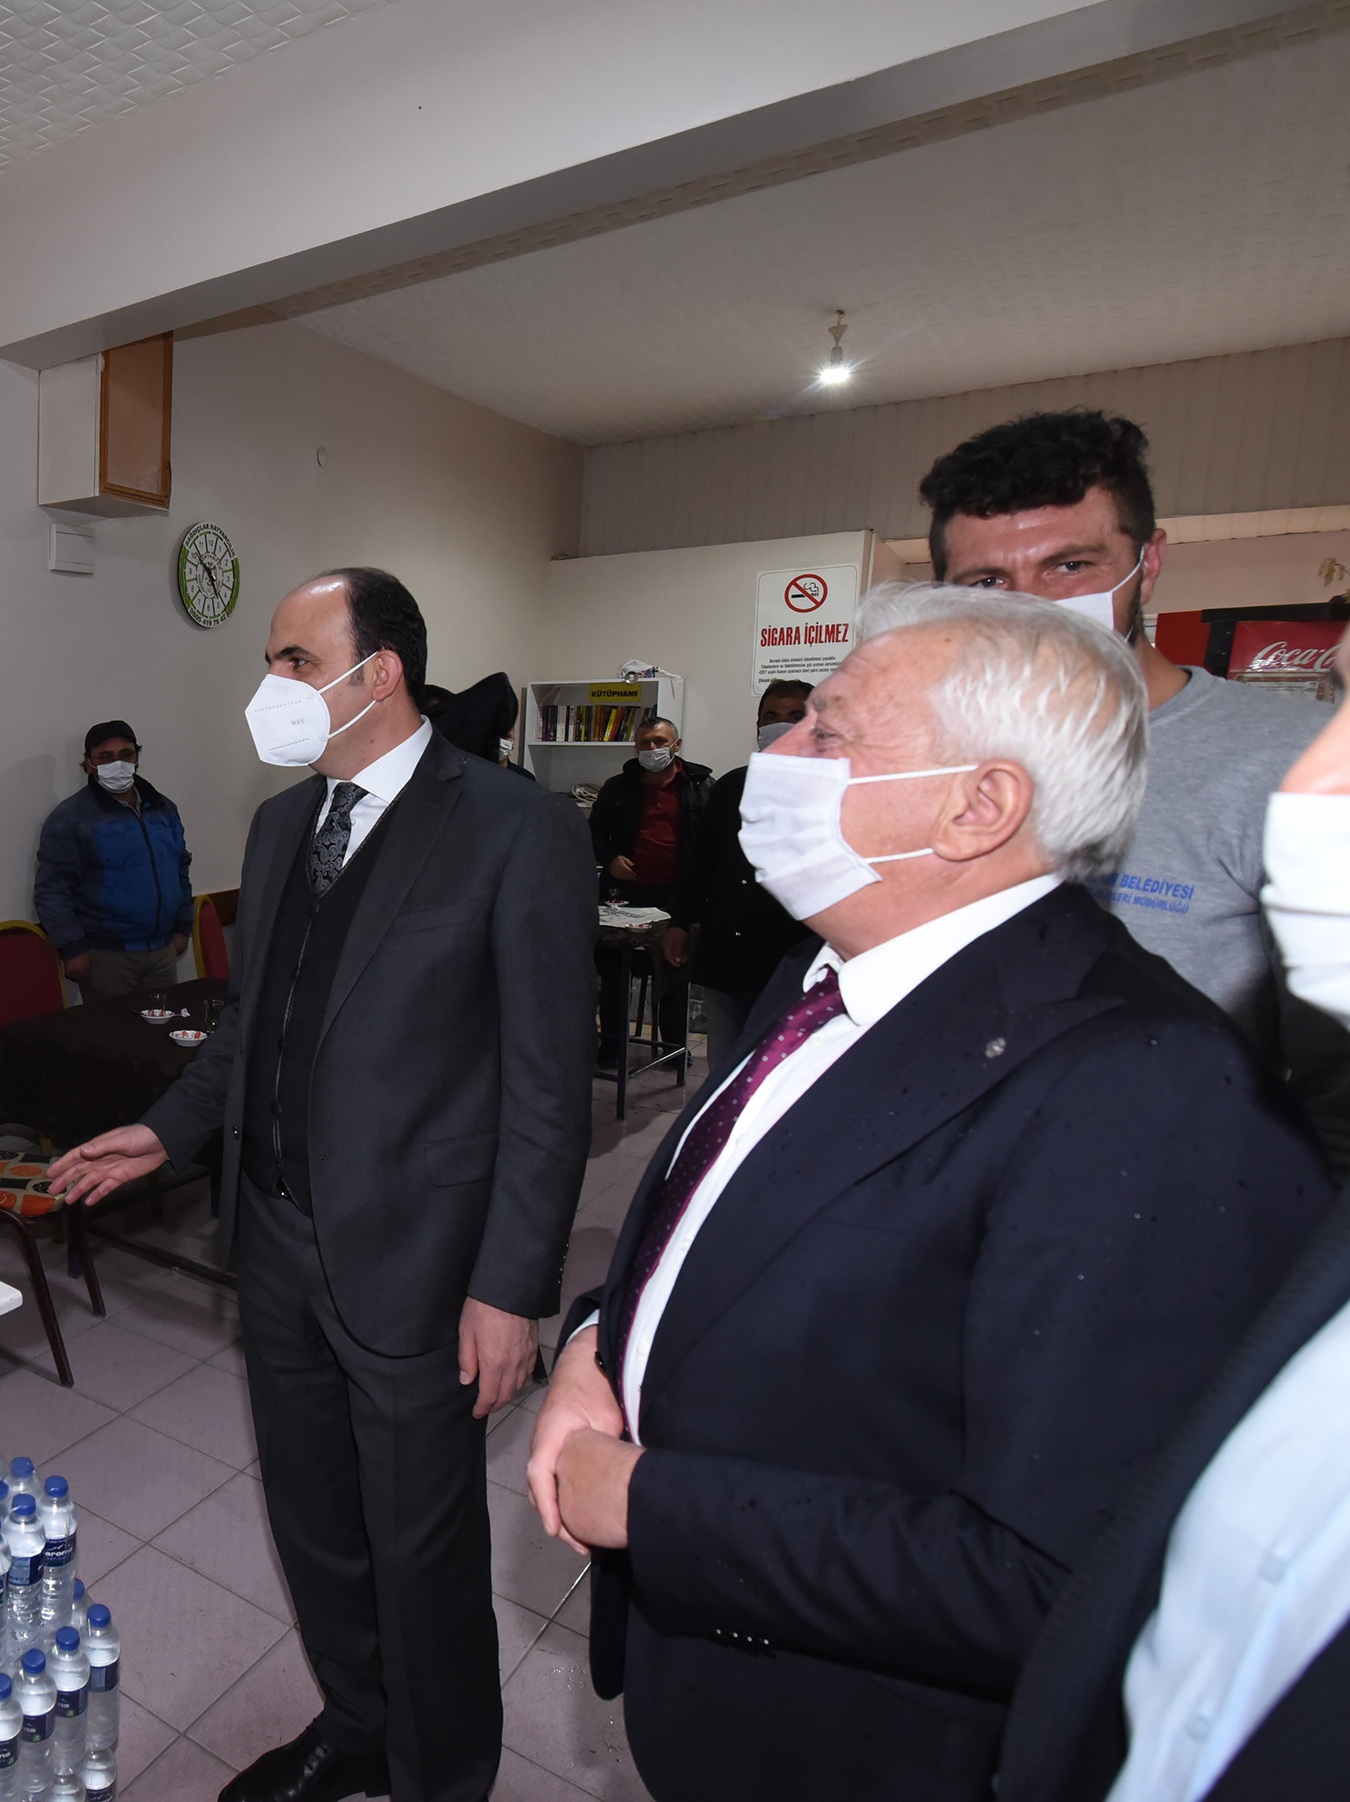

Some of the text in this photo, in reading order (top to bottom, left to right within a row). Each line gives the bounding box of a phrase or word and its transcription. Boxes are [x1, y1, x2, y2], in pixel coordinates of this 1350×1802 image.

[760, 622, 849, 647] SİGARA İÇİLMEZ
[591, 689, 639, 698] KÜTÜPHANE
[1119, 874, 1195, 900] BELEDİYESİ
